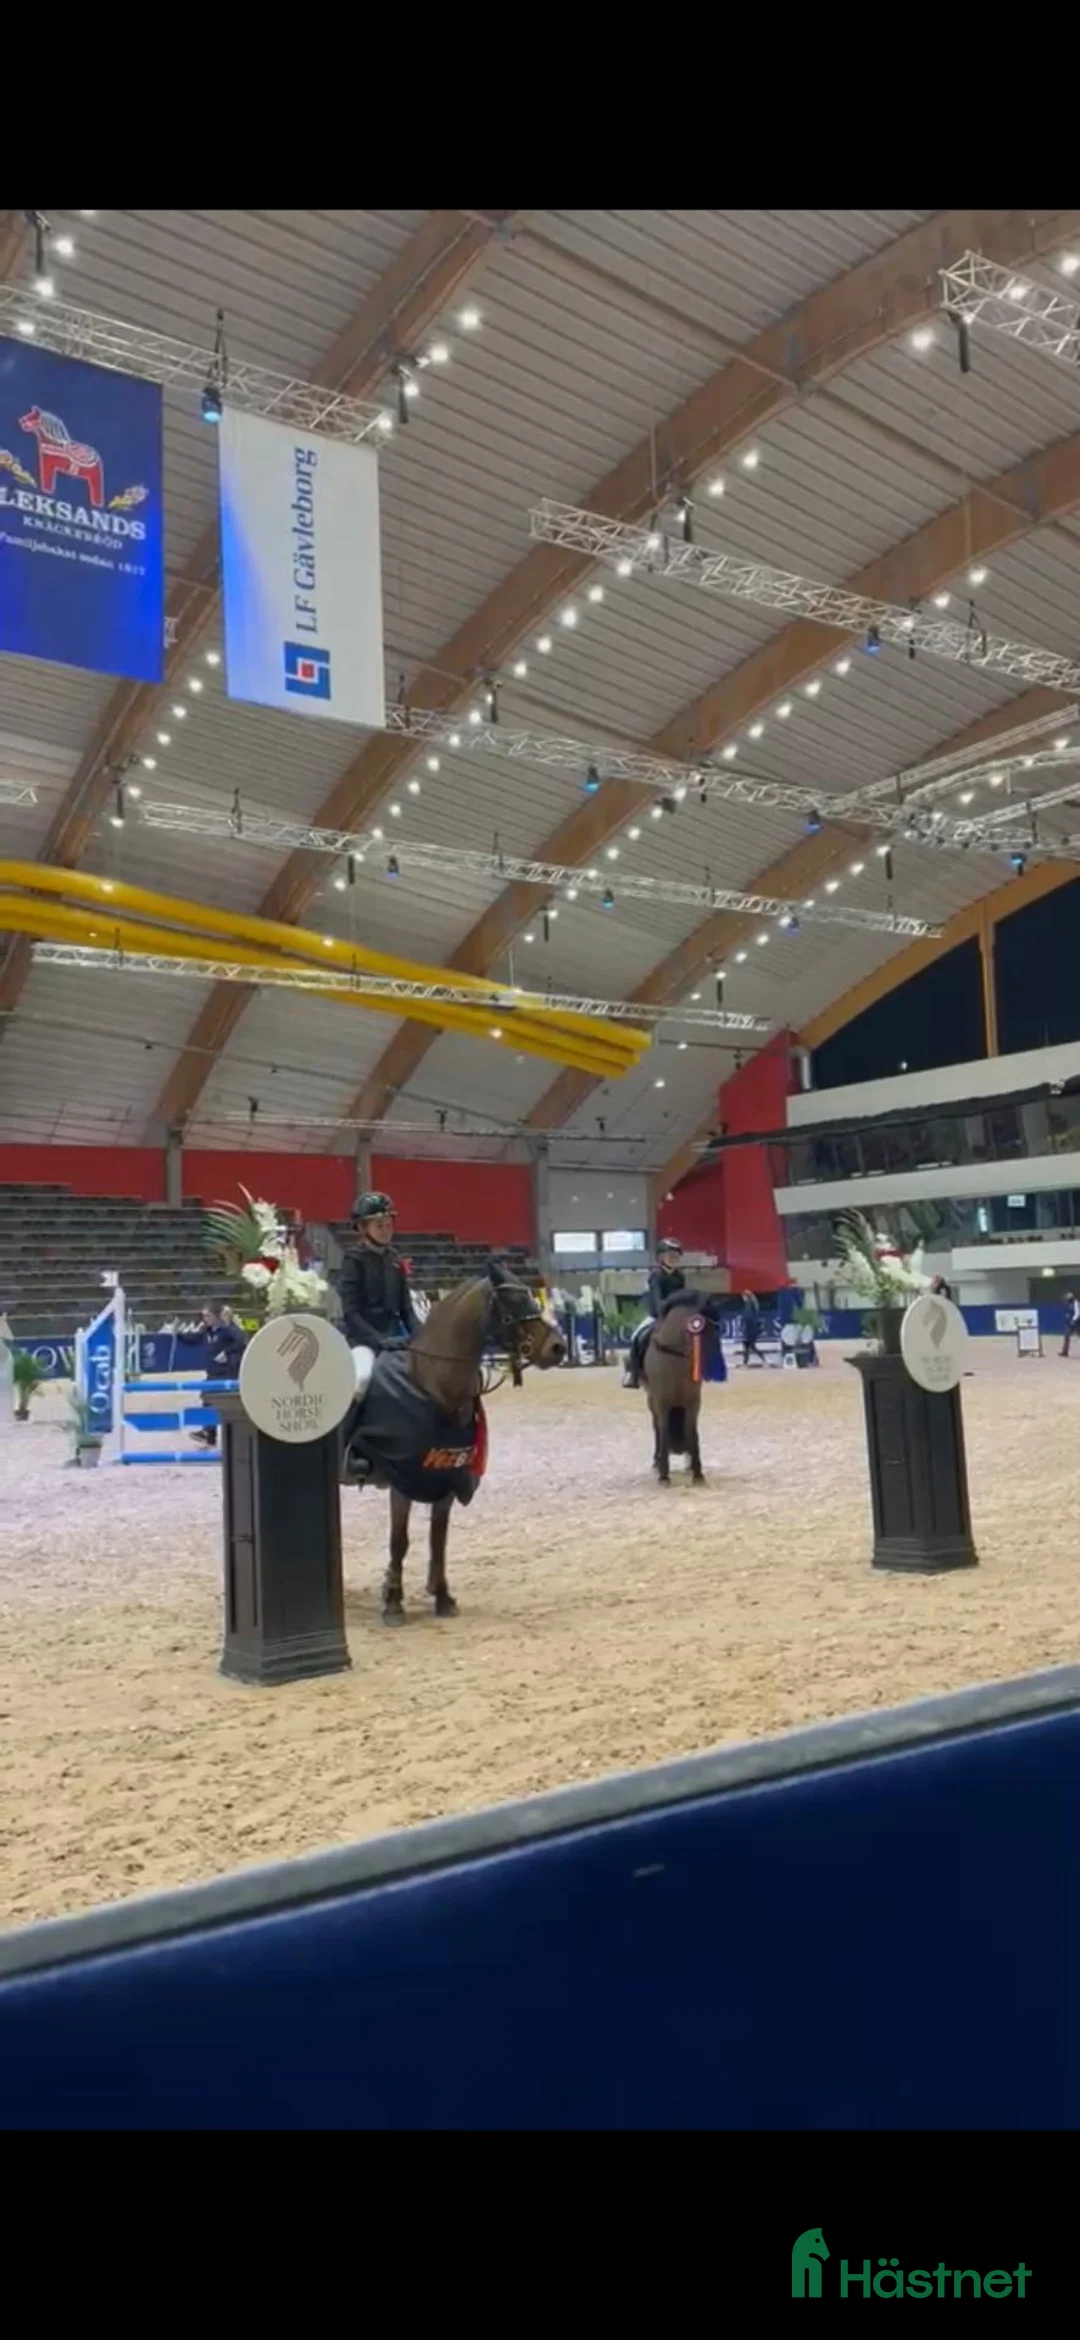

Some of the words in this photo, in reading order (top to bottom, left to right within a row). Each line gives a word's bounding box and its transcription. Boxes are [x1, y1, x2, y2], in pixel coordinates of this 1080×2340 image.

[0, 486, 147, 541] LEKSANDS
[291, 446, 318, 591] Gävleborg
[295, 594, 318, 634] LF
[89, 1344, 111, 1414] Ocab
[271, 1393, 324, 1409] NORDIC
[274, 1406, 320, 1422] HORSE
[278, 1419, 319, 1433] SHOW
